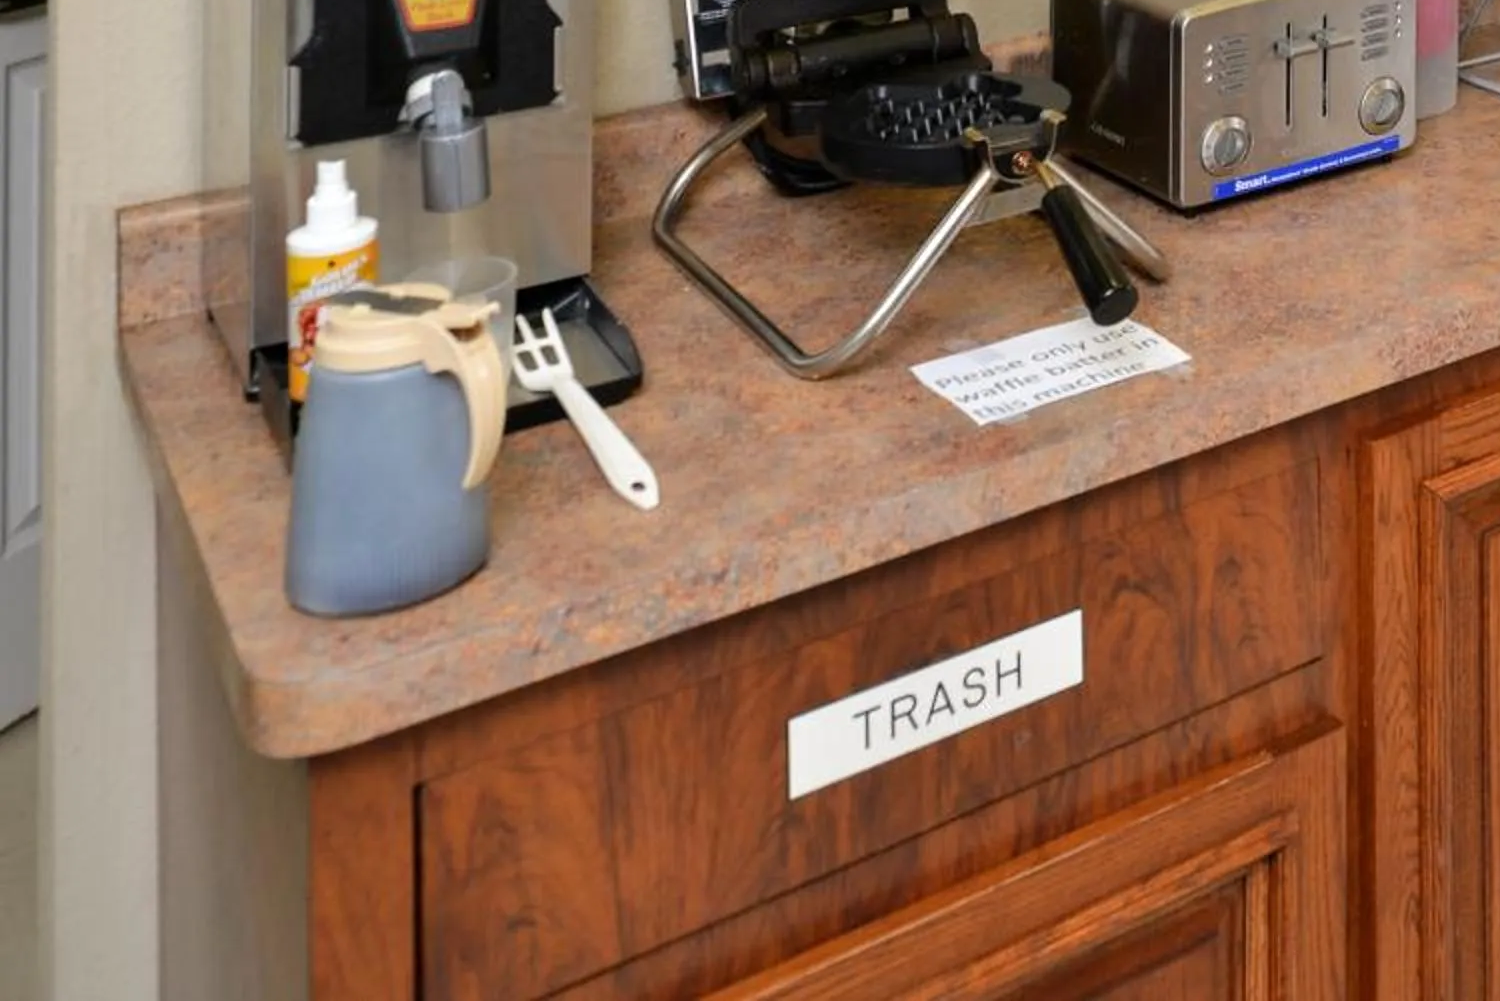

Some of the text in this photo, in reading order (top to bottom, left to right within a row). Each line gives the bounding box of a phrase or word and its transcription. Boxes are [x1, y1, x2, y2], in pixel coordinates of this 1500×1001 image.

[935, 323, 1138, 390] Please only use
[1045, 346, 1125, 377] batter
[1135, 335, 1159, 351] in
[971, 360, 1146, 420] this machine
[852, 650, 1023, 750] TRASH
